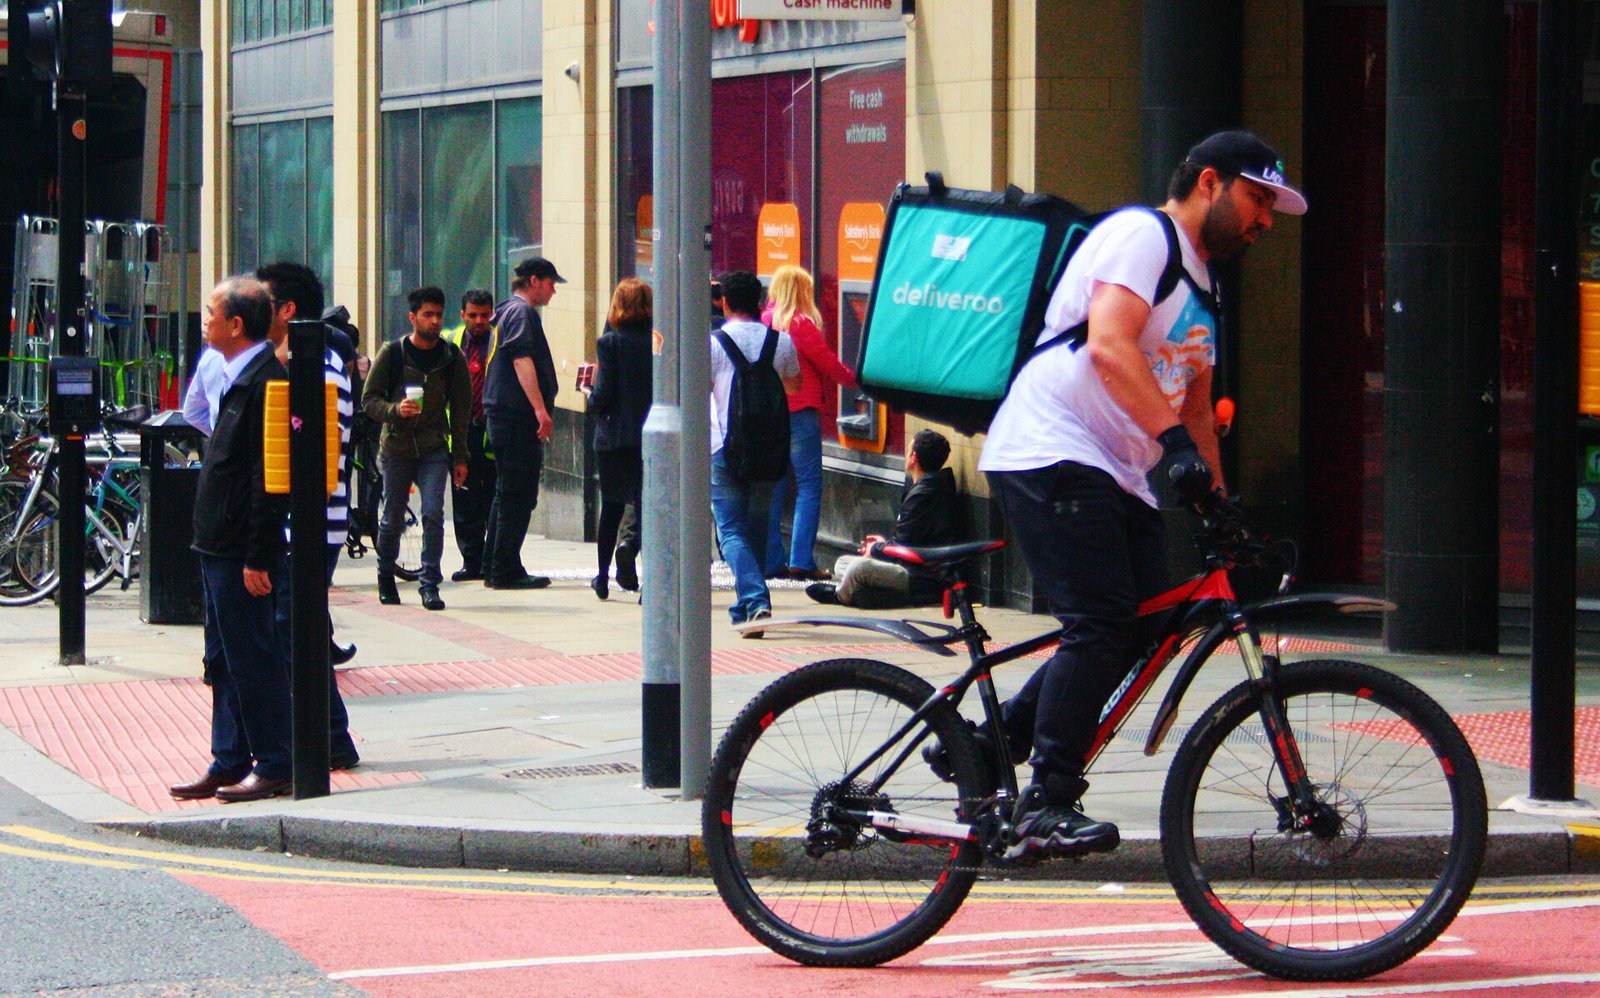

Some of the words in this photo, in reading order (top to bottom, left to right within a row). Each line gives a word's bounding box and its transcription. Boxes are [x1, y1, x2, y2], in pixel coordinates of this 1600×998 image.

[783, 0, 819, 9] Cash
[826, 0, 892, 9] machine
[849, 88, 865, 110] Free
[866, 88, 883, 108] cash
[845, 122, 887, 144] withdrawals
[892, 281, 1004, 314] deliveroo
